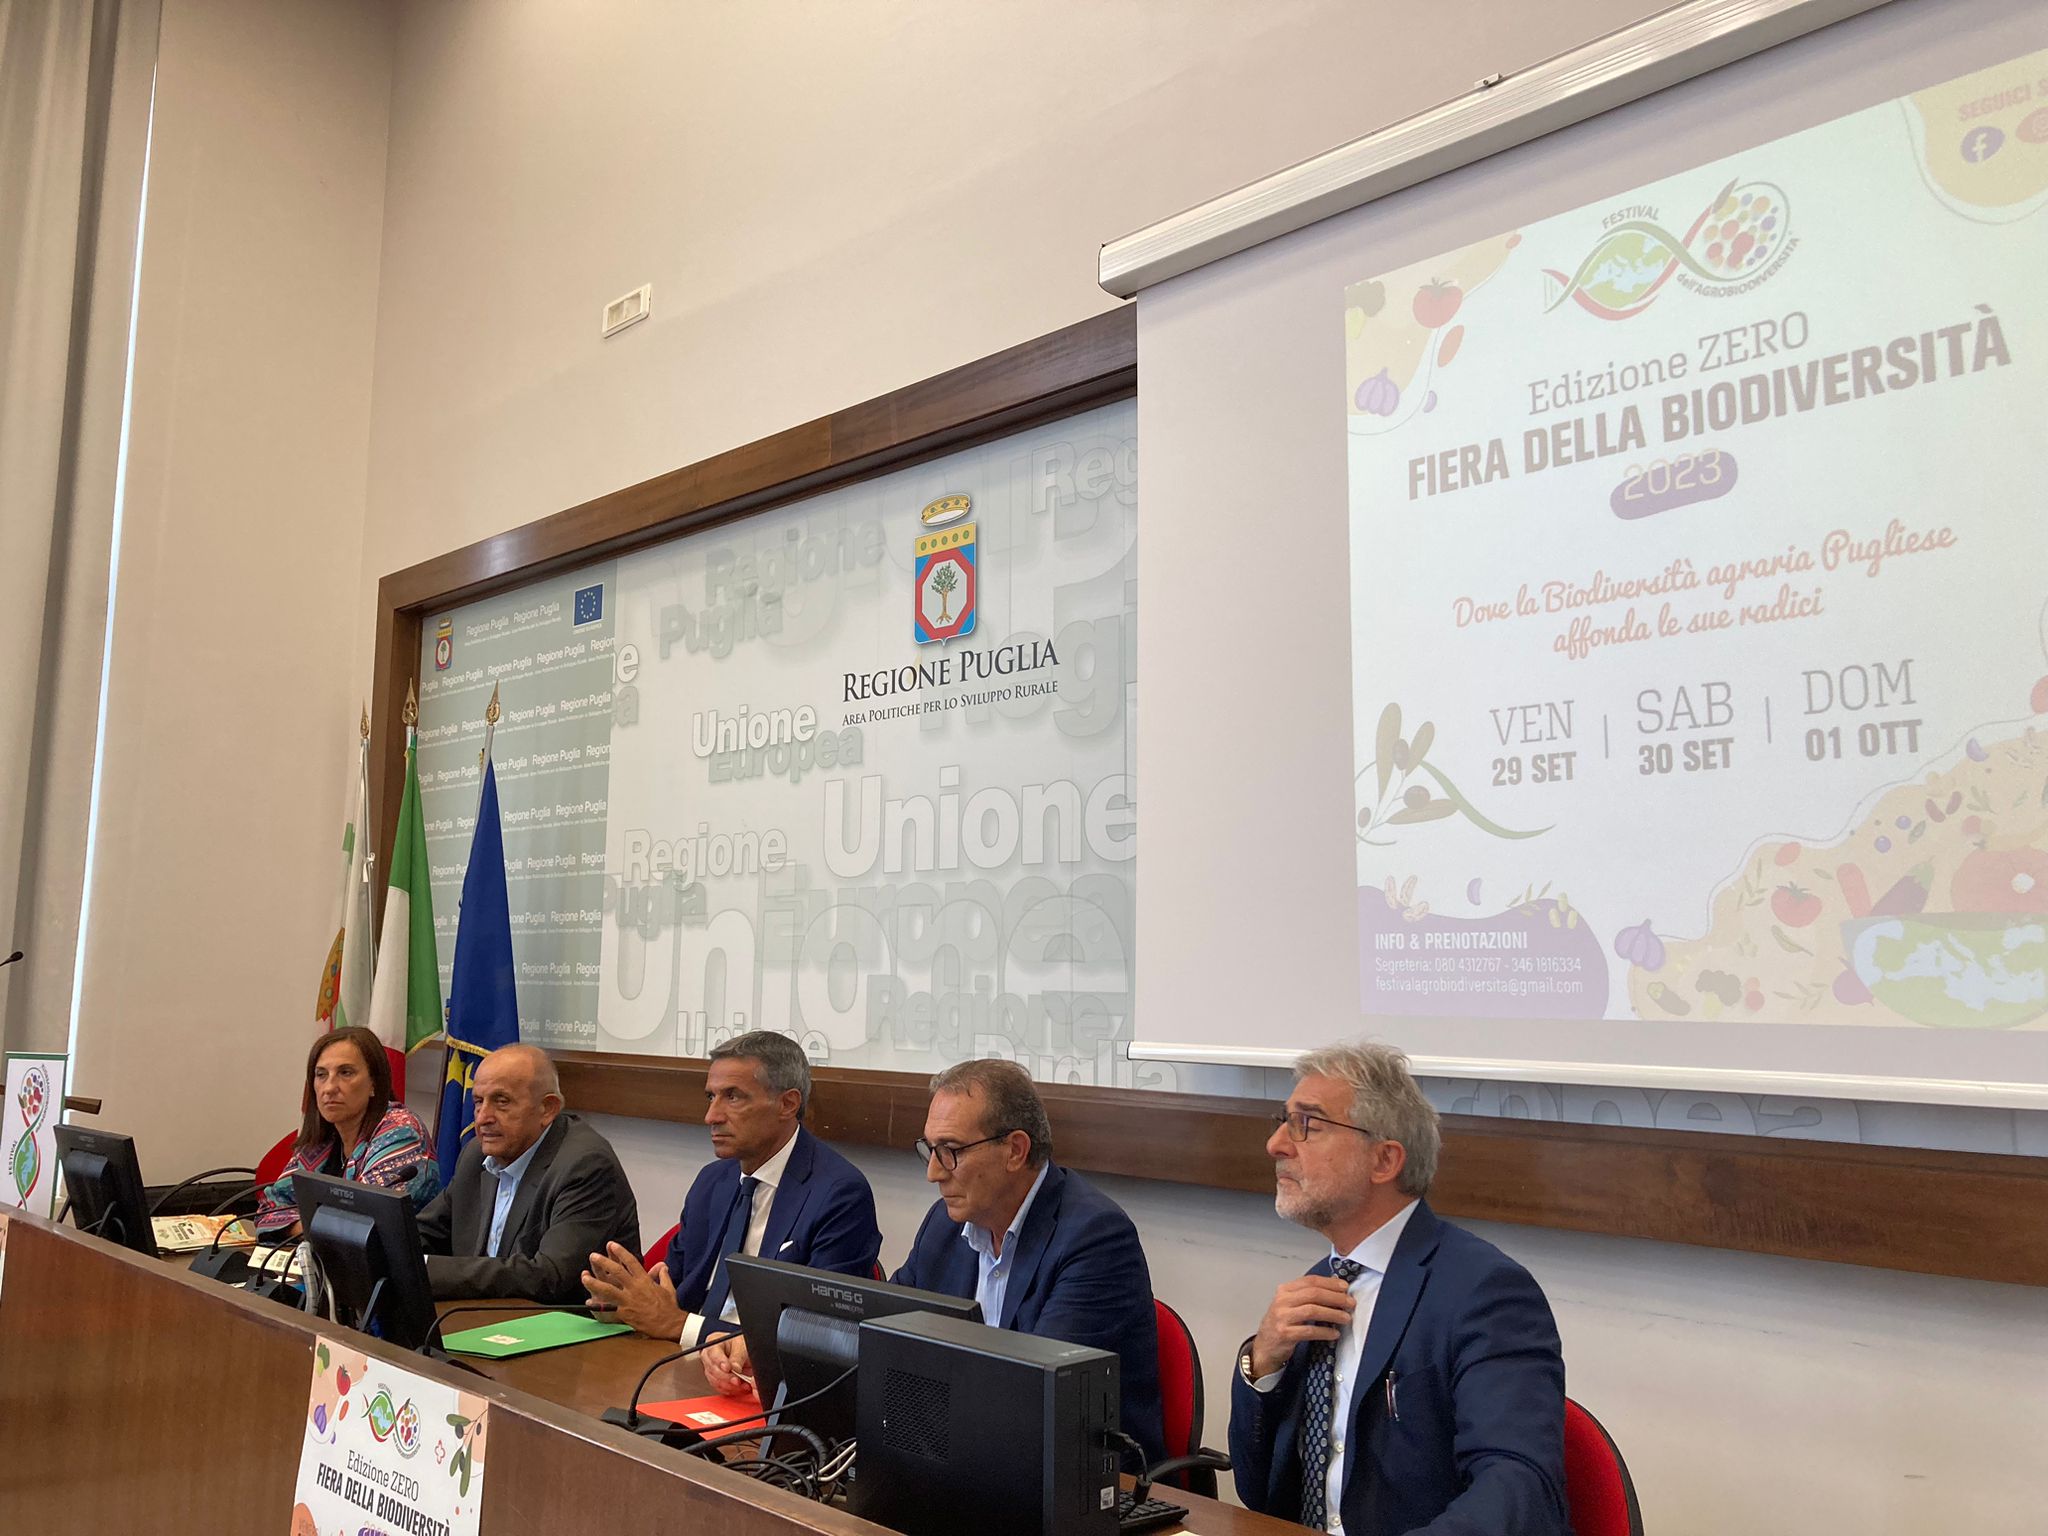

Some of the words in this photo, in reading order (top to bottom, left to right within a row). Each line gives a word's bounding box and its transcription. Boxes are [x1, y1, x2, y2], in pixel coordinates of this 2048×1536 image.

[1959, 84, 2031, 121] SEGUICI
[1601, 205, 1660, 230] FESTIVAL
[1528, 351, 1687, 415] Edizione
[1698, 311, 1809, 372] ZERO
[1408, 436, 1509, 500] FIERA
[1523, 404, 1646, 473] DELLA
[1662, 303, 2012, 443] BIODIVERSITÀ
[1623, 447, 1723, 500] 2023
[1453, 595, 1511, 628] Dove
[1516, 584, 1539, 616] la
[1541, 558, 1700, 614] Biodiversità
[1706, 545, 1814, 599] agraria
[1820, 518, 1958, 578] Pugliese
[466, 620, 491, 637] Regione
[490, 616, 509, 631] Puglia
[513, 609, 539, 624] Regione
[539, 601, 560, 616] Puglia
[1553, 606, 1652, 660] affonda
[1656, 602, 1682, 637] le
[1686, 607, 1734, 633] sue
[1739, 588, 1824, 626] radici
[442, 672, 465, 687] Regione
[466, 668, 483, 683] Puglia
[488, 661, 512, 676] Regione
[513, 657, 532, 672] Puglia
[537, 649, 563, 665] Regione
[564, 644, 585, 658] Puglia
[842, 658, 951, 703] REGIONE
[959, 638, 1061, 683] PUGLIA
[842, 712, 867, 726] AREA
[868, 702, 921, 723] POLITICHE
[923, 698, 942, 714] PER
[944, 696, 958, 711] LO
[960, 687, 1012, 708] SVILUPPO
[1015, 680, 1058, 699] RURALE
[1801, 658, 1917, 715] DOM
[509, 708, 534, 723] Regione
[535, 704, 556, 719] Puglia
[560, 697, 588, 712] Regione
[589, 692, 611, 707] Puglia
[1489, 700, 1575, 746] VEN
[1636, 681, 1735, 735] SAB
[440, 724, 458, 739] Puglia
[692, 704, 817, 758] Unione
[1804, 728, 1842, 761] 01
[1858, 719, 1923, 757] OTT
[437, 767, 460, 782] Regione
[461, 764, 479, 779] Puglia
[508, 757, 527, 772] Puglia
[532, 751, 559, 766] Regione
[560, 746, 581, 762] Puglia
[708, 726, 864, 784] Europea
[1491, 758, 1523, 787] 29
[1531, 751, 1577, 783] SET
[1638, 744, 1673, 776] 30
[1682, 737, 1735, 771] SET
[435, 819, 453, 832] Puglia
[504, 809, 530, 824] Regione
[530, 806, 551, 820] Puglia
[556, 803, 584, 818] Regione
[585, 799, 607, 813] Puglia
[824, 764, 1137, 879] Unione
[432, 865, 455, 878] Regione
[527, 856, 554, 869] Regione
[555, 853, 576, 867] Puglia
[623, 822, 788, 892] Regione
[525, 911, 545, 925] Puglia
[551, 910, 578, 924] Regione
[579, 909, 601, 922] Puglia
[1375, 933, 1405, 950] INFO
[1409, 933, 1420, 950] &
[1425, 931, 1528, 950] PRENOTAZIONI
[522, 962, 549, 977] Regione
[550, 962, 570, 976] Puglia
[1375, 957, 1432, 975] Segreteria:
[1435, 957, 1455, 972] 080
[1511, 957, 1533, 972] 346
[1375, 977, 1583, 996] festivalagrobiodiversita@gmail.com
[545, 1018, 573, 1034] Regione
[574, 1020, 595, 1034] Puglia
[347, 1449, 390, 1488] Edizione
[391, 1471, 419, 1502] ZERO
[316, 1462, 342, 1498] FIERA
[344, 1476, 375, 1513] DELLA
[376, 1492, 451, 1536] BIODIVERSITÀ
